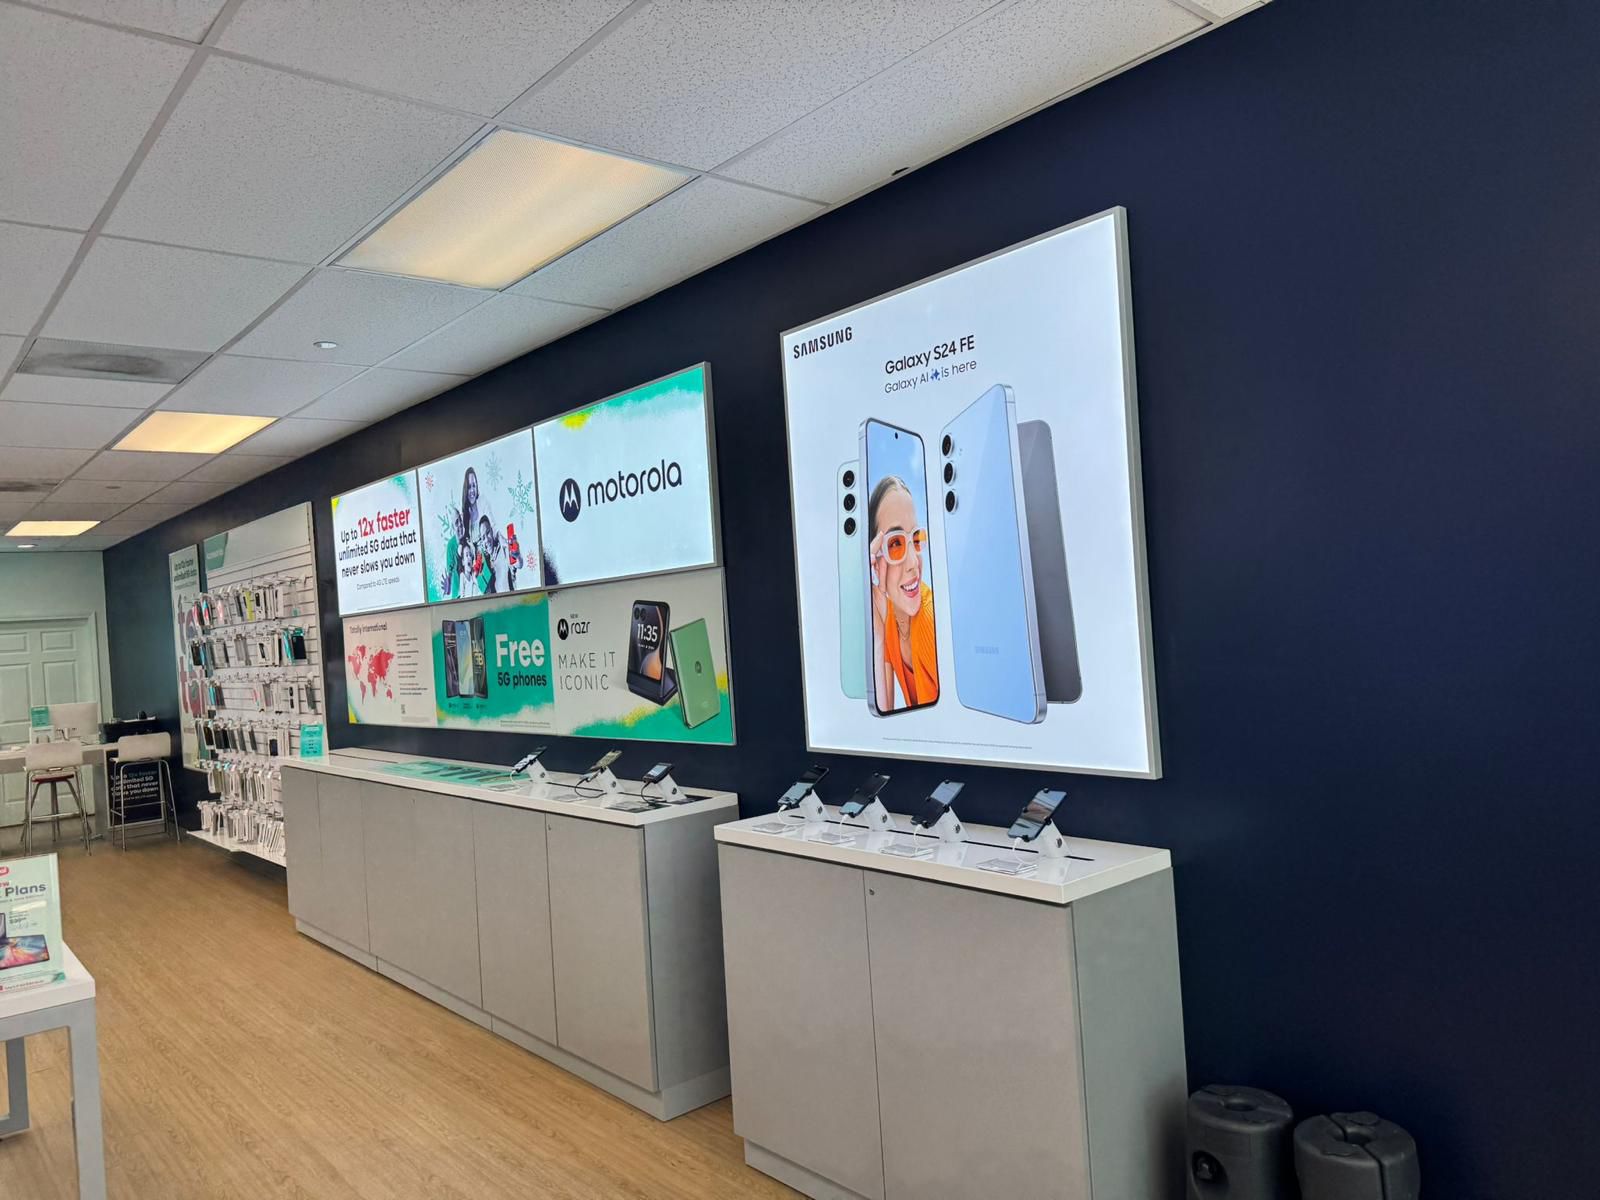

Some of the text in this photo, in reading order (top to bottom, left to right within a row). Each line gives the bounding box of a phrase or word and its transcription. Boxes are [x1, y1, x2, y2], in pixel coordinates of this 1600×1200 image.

[793, 326, 853, 359] SAMSUNG
[885, 335, 975, 374] Galaxy S24 FE
[884, 360, 977, 394] Galaxy AI is here
[587, 459, 682, 507] motorola
[341, 508, 411, 545] Up to 12x faster
[339, 529, 417, 561] unlimited 5G data that
[341, 552, 416, 578] never slows you down
[570, 621, 591, 634] razr
[637, 623, 658, 642] 11:35
[495, 633, 545, 668] Free
[558, 651, 616, 670] MAKE IT
[498, 669, 547, 689] 5G phones
[560, 673, 610, 691] ICONIC
[5, 884, 47, 897] Plans
